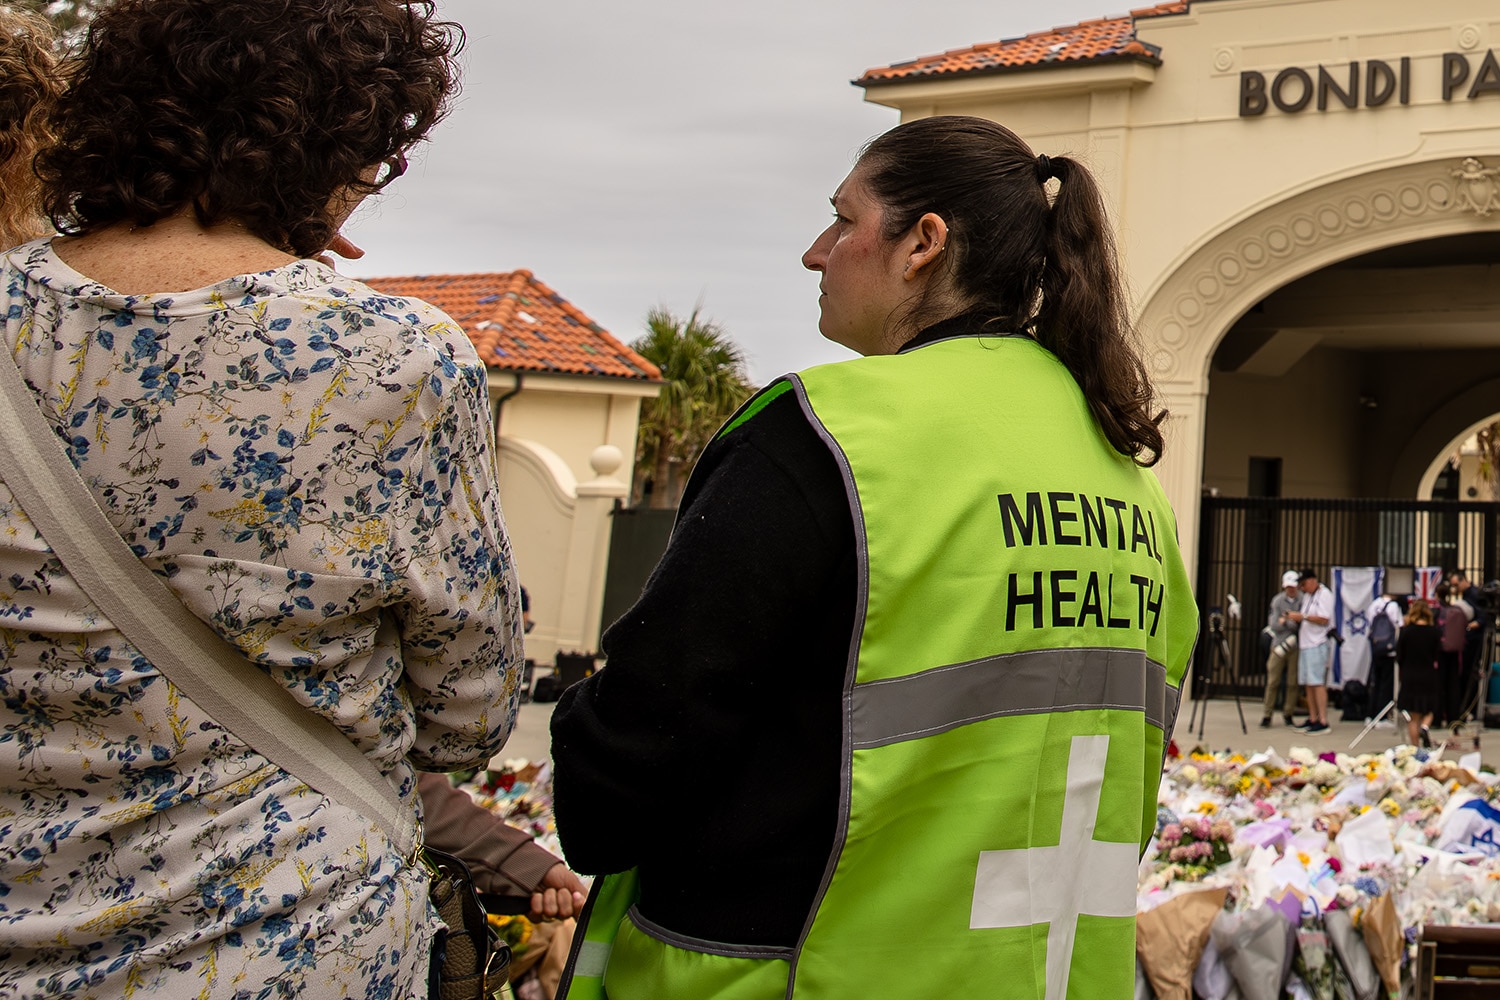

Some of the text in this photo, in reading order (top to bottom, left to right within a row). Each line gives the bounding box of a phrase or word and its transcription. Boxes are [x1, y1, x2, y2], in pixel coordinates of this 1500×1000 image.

[1239, 56, 1411, 118] BONDI
[997, 491, 1162, 565] MENTAL
[1005, 570, 1164, 637] HEALTH
